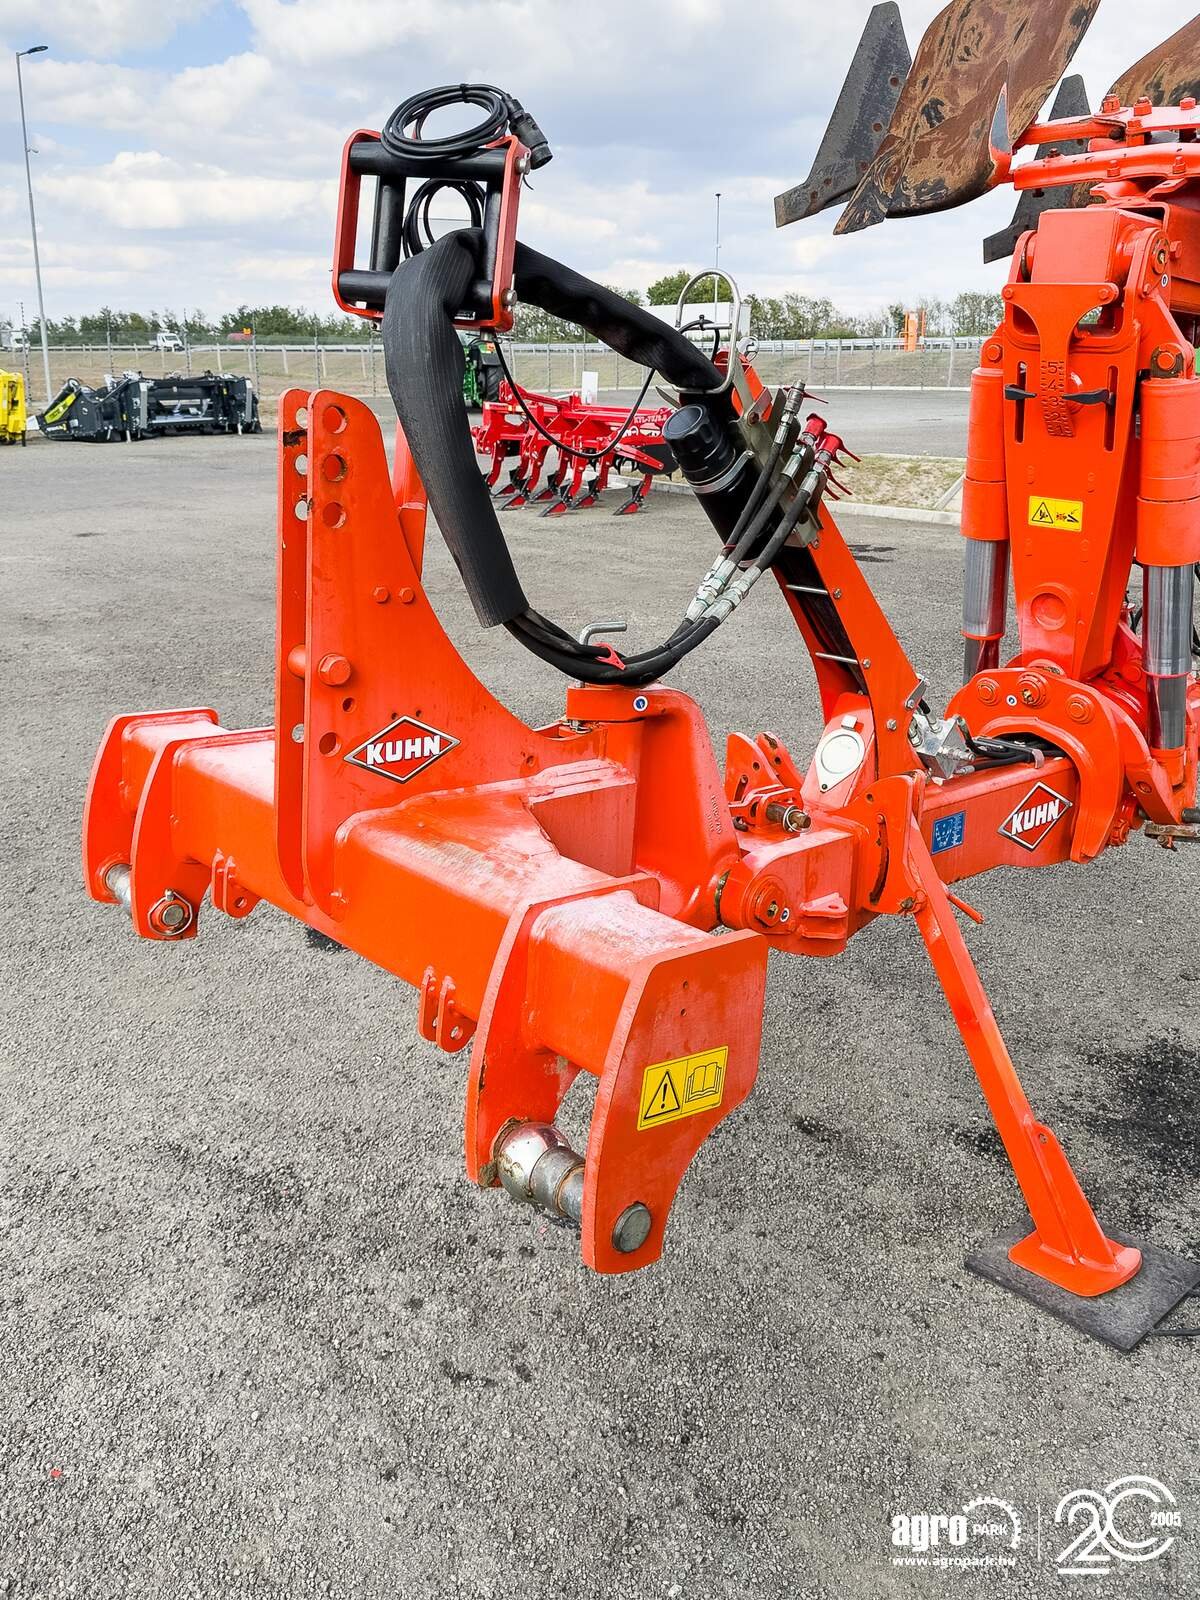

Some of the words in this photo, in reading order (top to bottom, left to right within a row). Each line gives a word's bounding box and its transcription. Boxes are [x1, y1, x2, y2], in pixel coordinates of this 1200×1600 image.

[1047, 361, 1059, 374] 5
[1047, 378, 1058, 392] 4
[1048, 396, 1059, 407] 3
[366, 735, 441, 766] KUHN
[1011, 798, 1060, 836] KUHN
